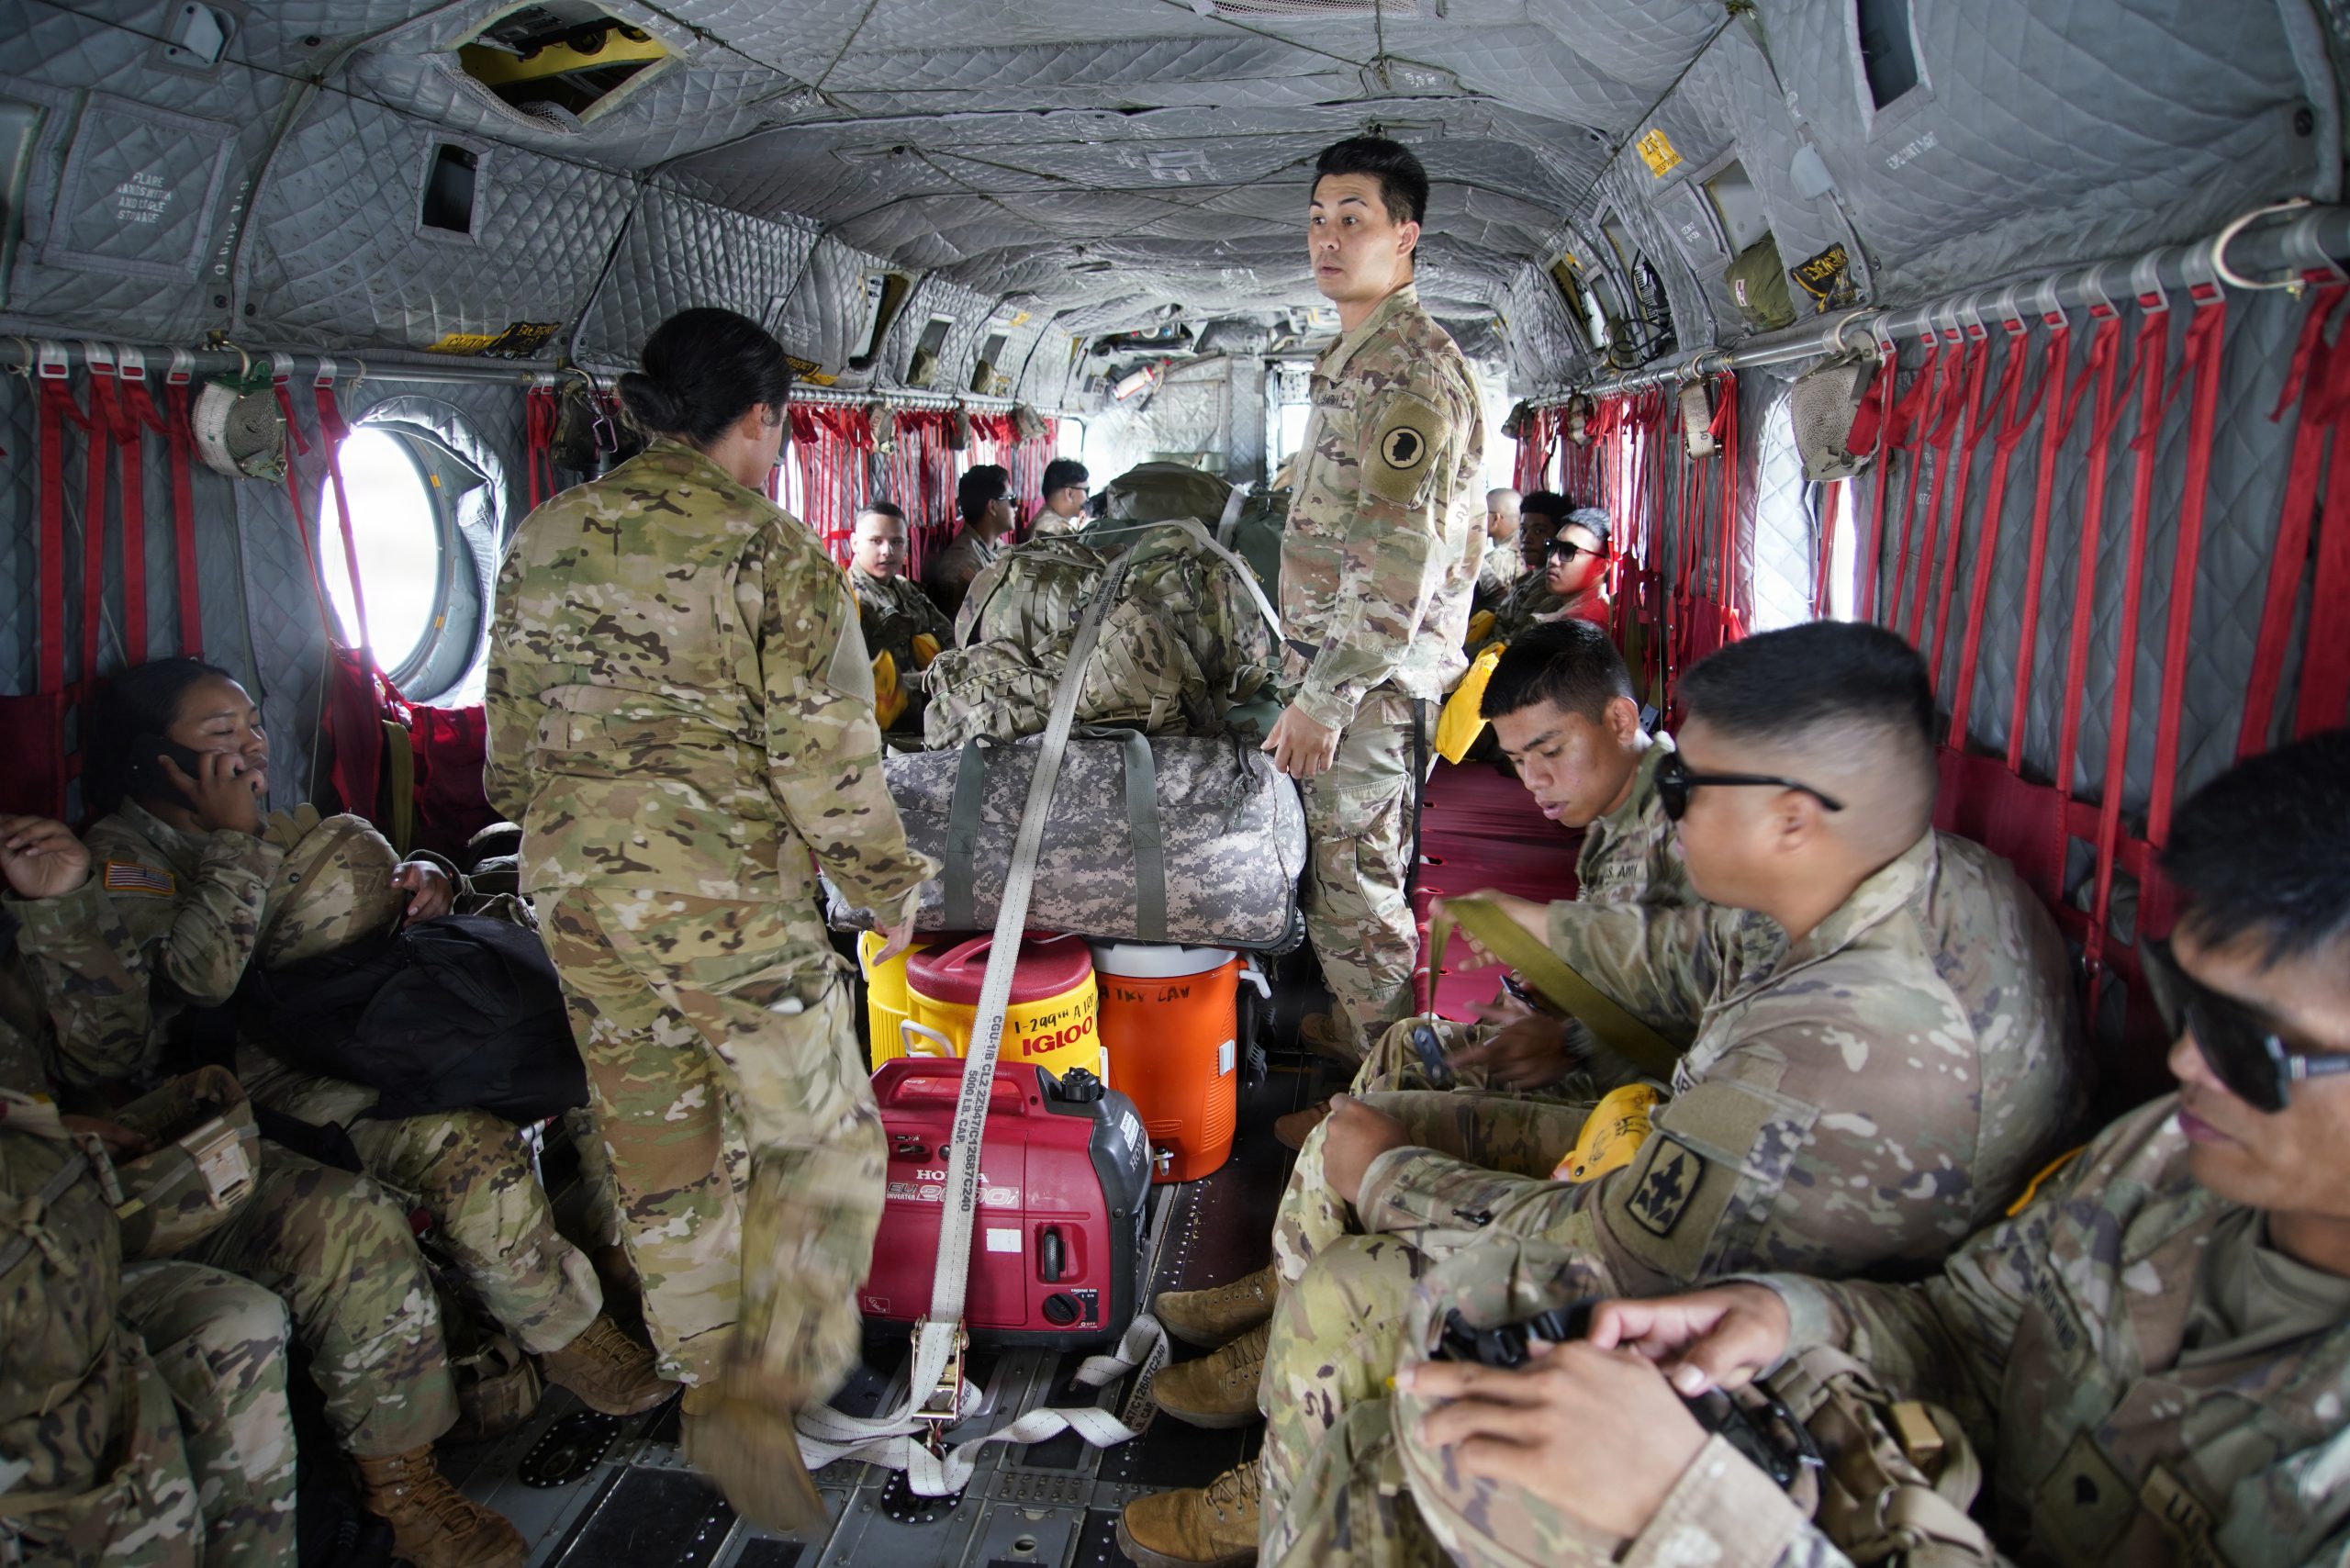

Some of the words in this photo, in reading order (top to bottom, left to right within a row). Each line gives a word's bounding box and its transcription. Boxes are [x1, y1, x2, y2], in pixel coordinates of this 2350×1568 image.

[133, 172, 164, 187] FLARE
[118, 196, 138, 208] AND
[1073, 1004, 1081, 1020] A
[984, 1015, 1002, 1060] CGU-1/B
[1023, 1015, 1093, 1057] IGLOO
[965, 1070, 979, 1095] 5000
[979, 1064, 992, 1087] CL2
[960, 1098, 973, 1116] LB.
[955, 1119, 968, 1144] CAP.
[961, 1090, 988, 1212] 22947/C12687C240
[916, 1169, 990, 1183] HOA
[888, 1182, 918, 1194] EU
[887, 1193, 916, 1202] INVERTER
